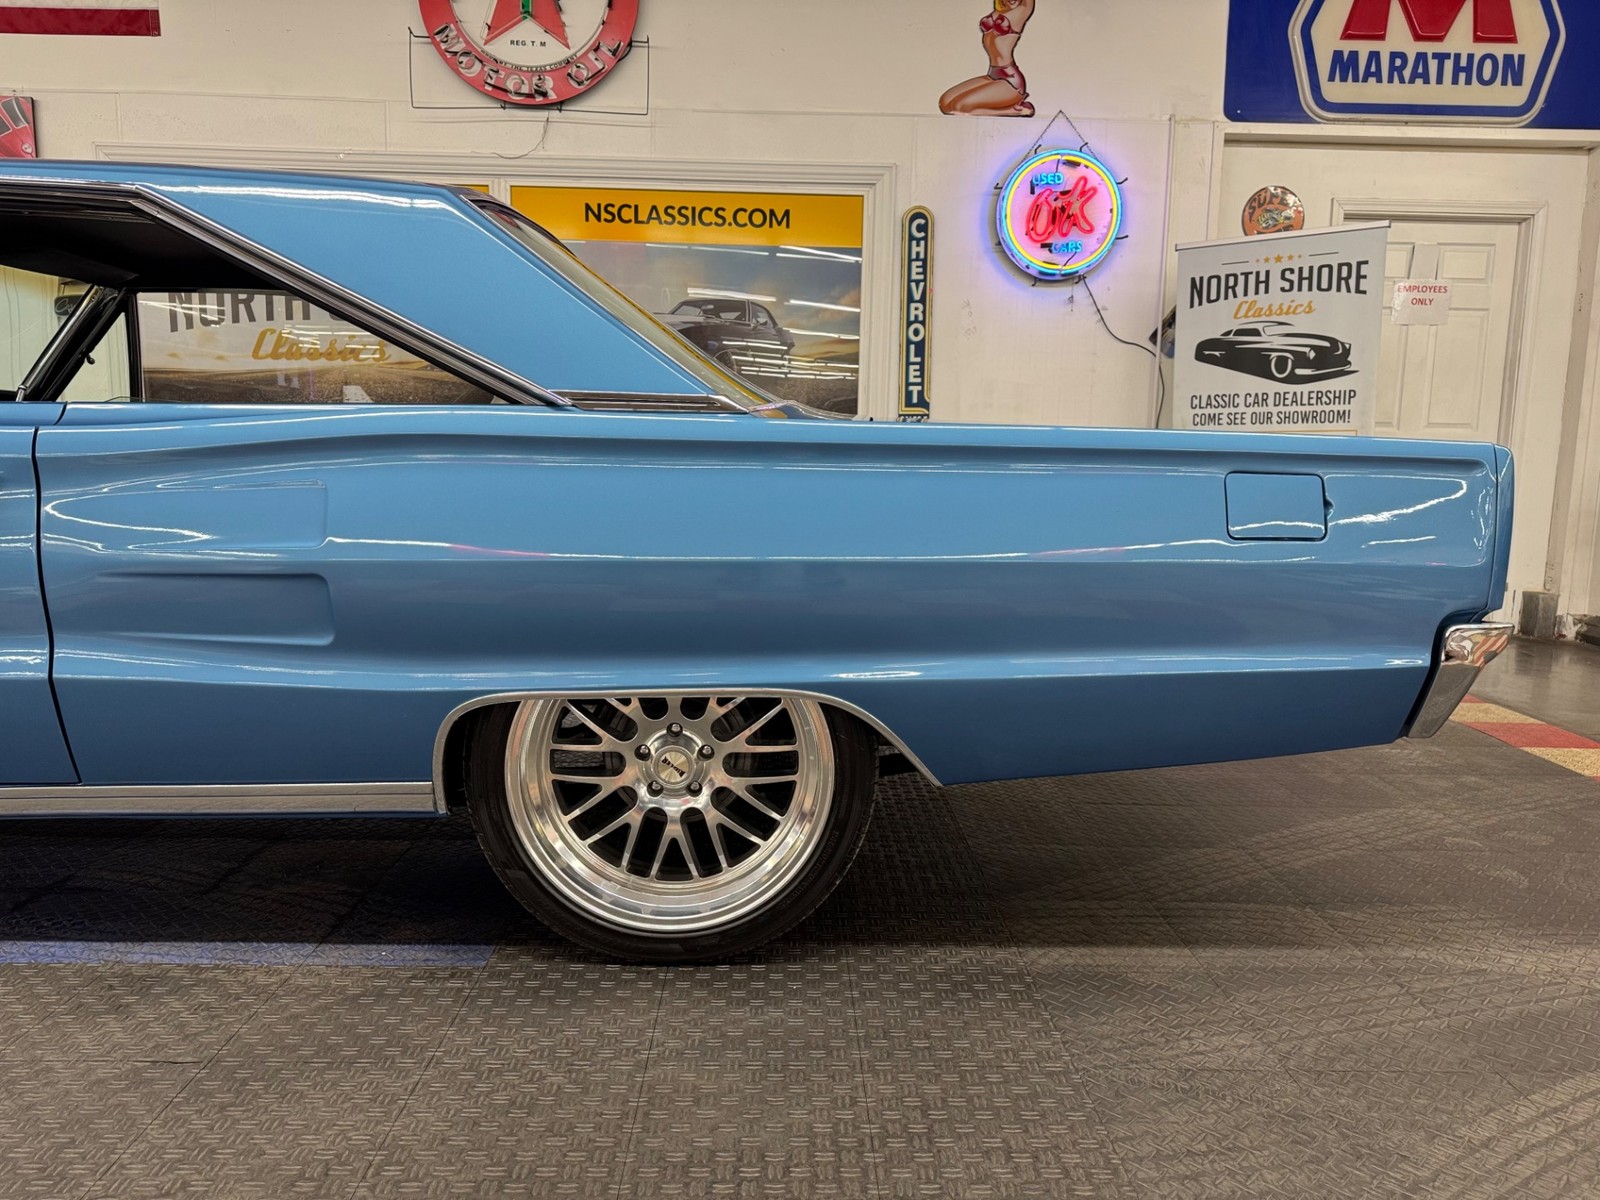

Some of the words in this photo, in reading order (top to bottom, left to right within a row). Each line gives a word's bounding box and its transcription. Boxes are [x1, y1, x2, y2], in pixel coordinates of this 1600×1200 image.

[433, 23, 558, 101] MOTOR
[567, 40, 624, 89] OIL
[1327, 49, 1526, 87] MARATHON
[1032, 172, 1064, 185] USED
[584, 202, 791, 229] NSCLASSICS.COM
[1026, 175, 1098, 243] OK
[1051, 241, 1083, 253] CARS
[1189, 269, 1271, 309] NORTH
[1279, 260, 1369, 295] SHORE
[1397, 285, 1448, 294] EMPLOYEES
[907, 218, 926, 404] CHEVROLET
[1233, 299, 1316, 319] Classics
[1411, 297, 1434, 306] ONLY
[251, 327, 392, 362] Classics
[1190, 393, 1240, 410] CLASSIC
[1244, 392, 1269, 408] CAR
[1273, 389, 1357, 407] DEALERSHIP
[1192, 412, 1223, 426] COME
[1226, 412, 1247, 425] SEE
[1250, 411, 1273, 425] OUR
[1276, 409, 1351, 425] SHOWROOM!
[661, 756, 686, 777] RIDLER
